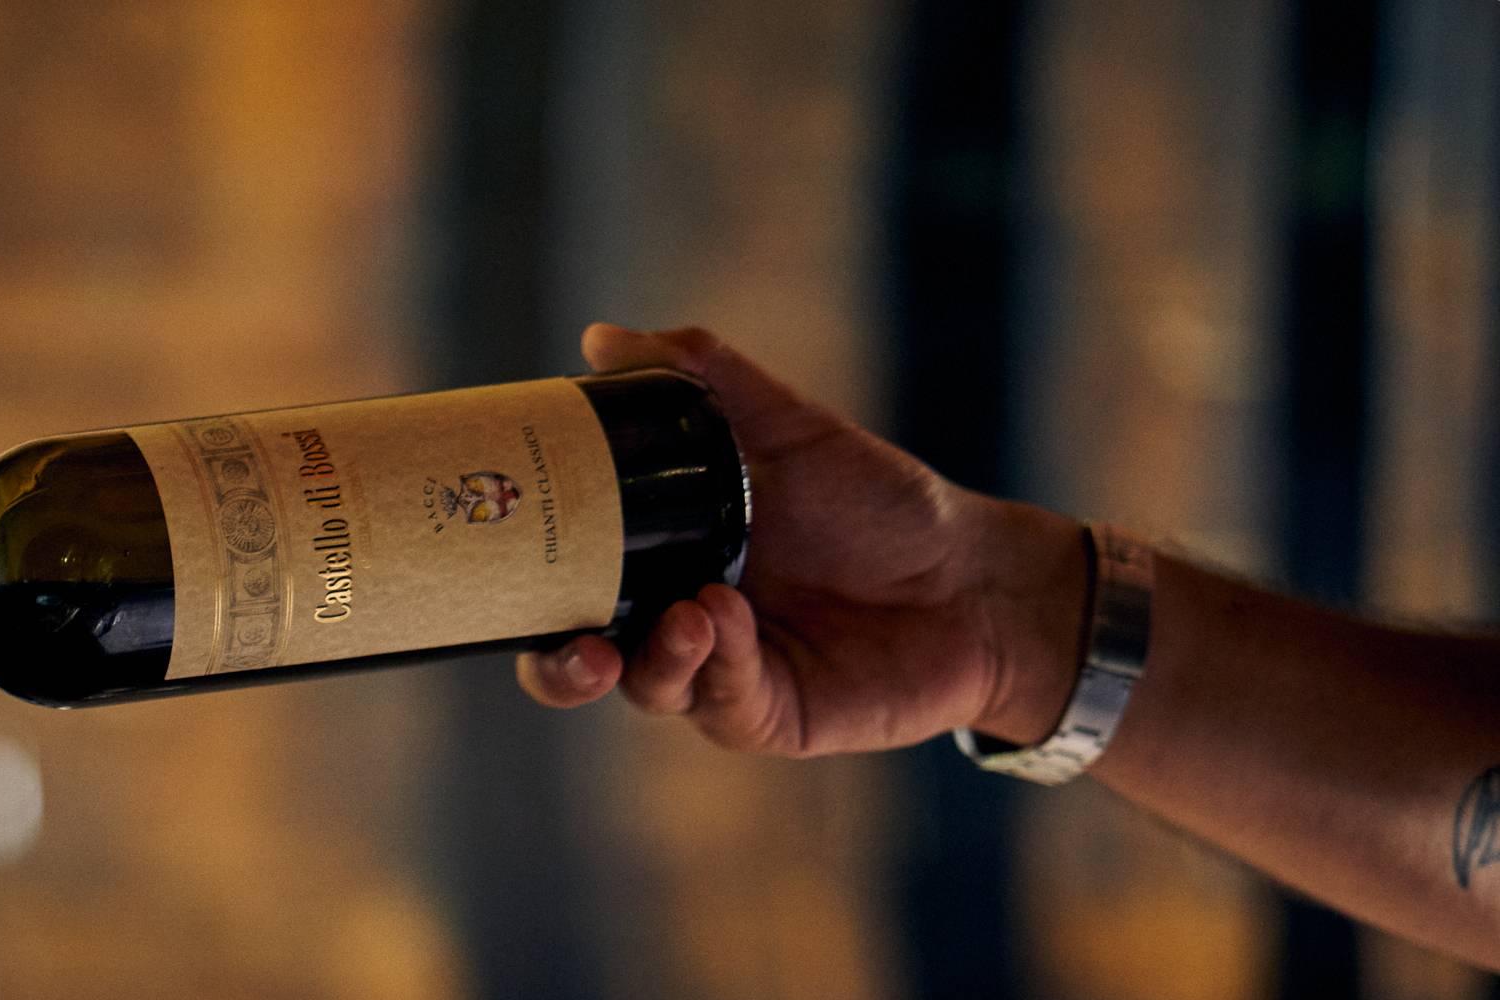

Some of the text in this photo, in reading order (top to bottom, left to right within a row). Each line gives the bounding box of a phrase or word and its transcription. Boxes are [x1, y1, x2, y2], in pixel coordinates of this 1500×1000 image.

[281, 429, 353, 624] Castello di Bossi
[423, 477, 444, 533] BACCI
[522, 425, 557, 564] CHIANTI CLASSICO
